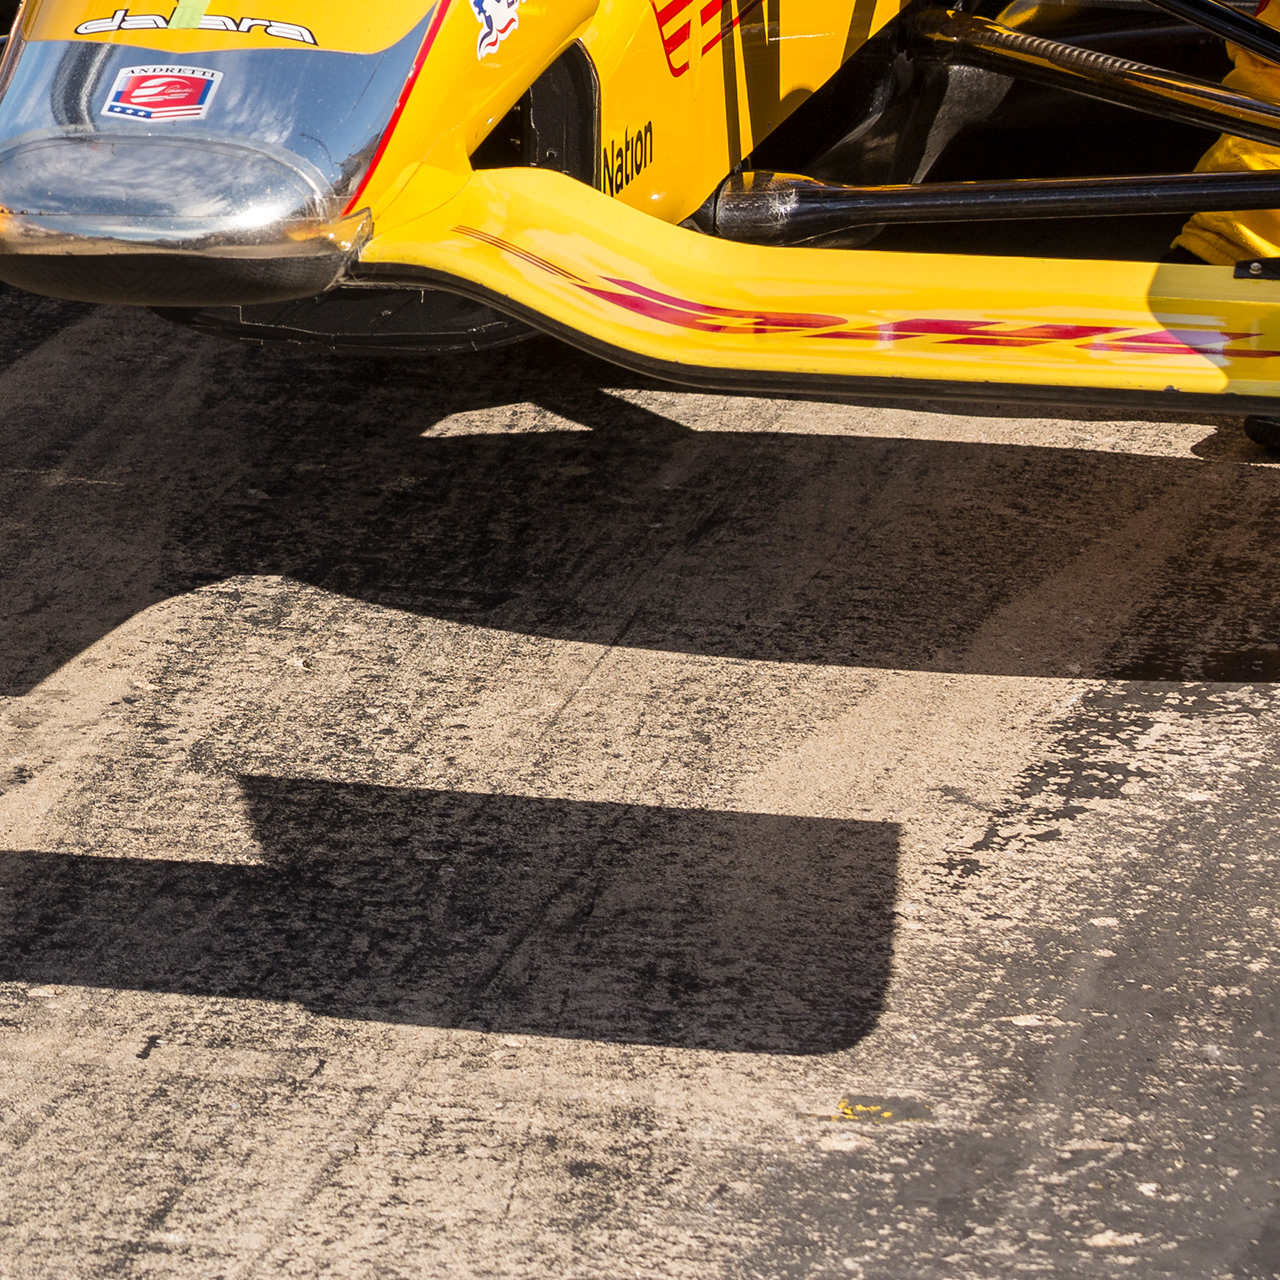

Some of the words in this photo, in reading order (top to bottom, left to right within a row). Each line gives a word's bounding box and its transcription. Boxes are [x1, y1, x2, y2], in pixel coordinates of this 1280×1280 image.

[74, 9, 319, 47] daara
[124, 66, 217, 79] ANDRETTI
[603, 119, 653, 198] Nation
